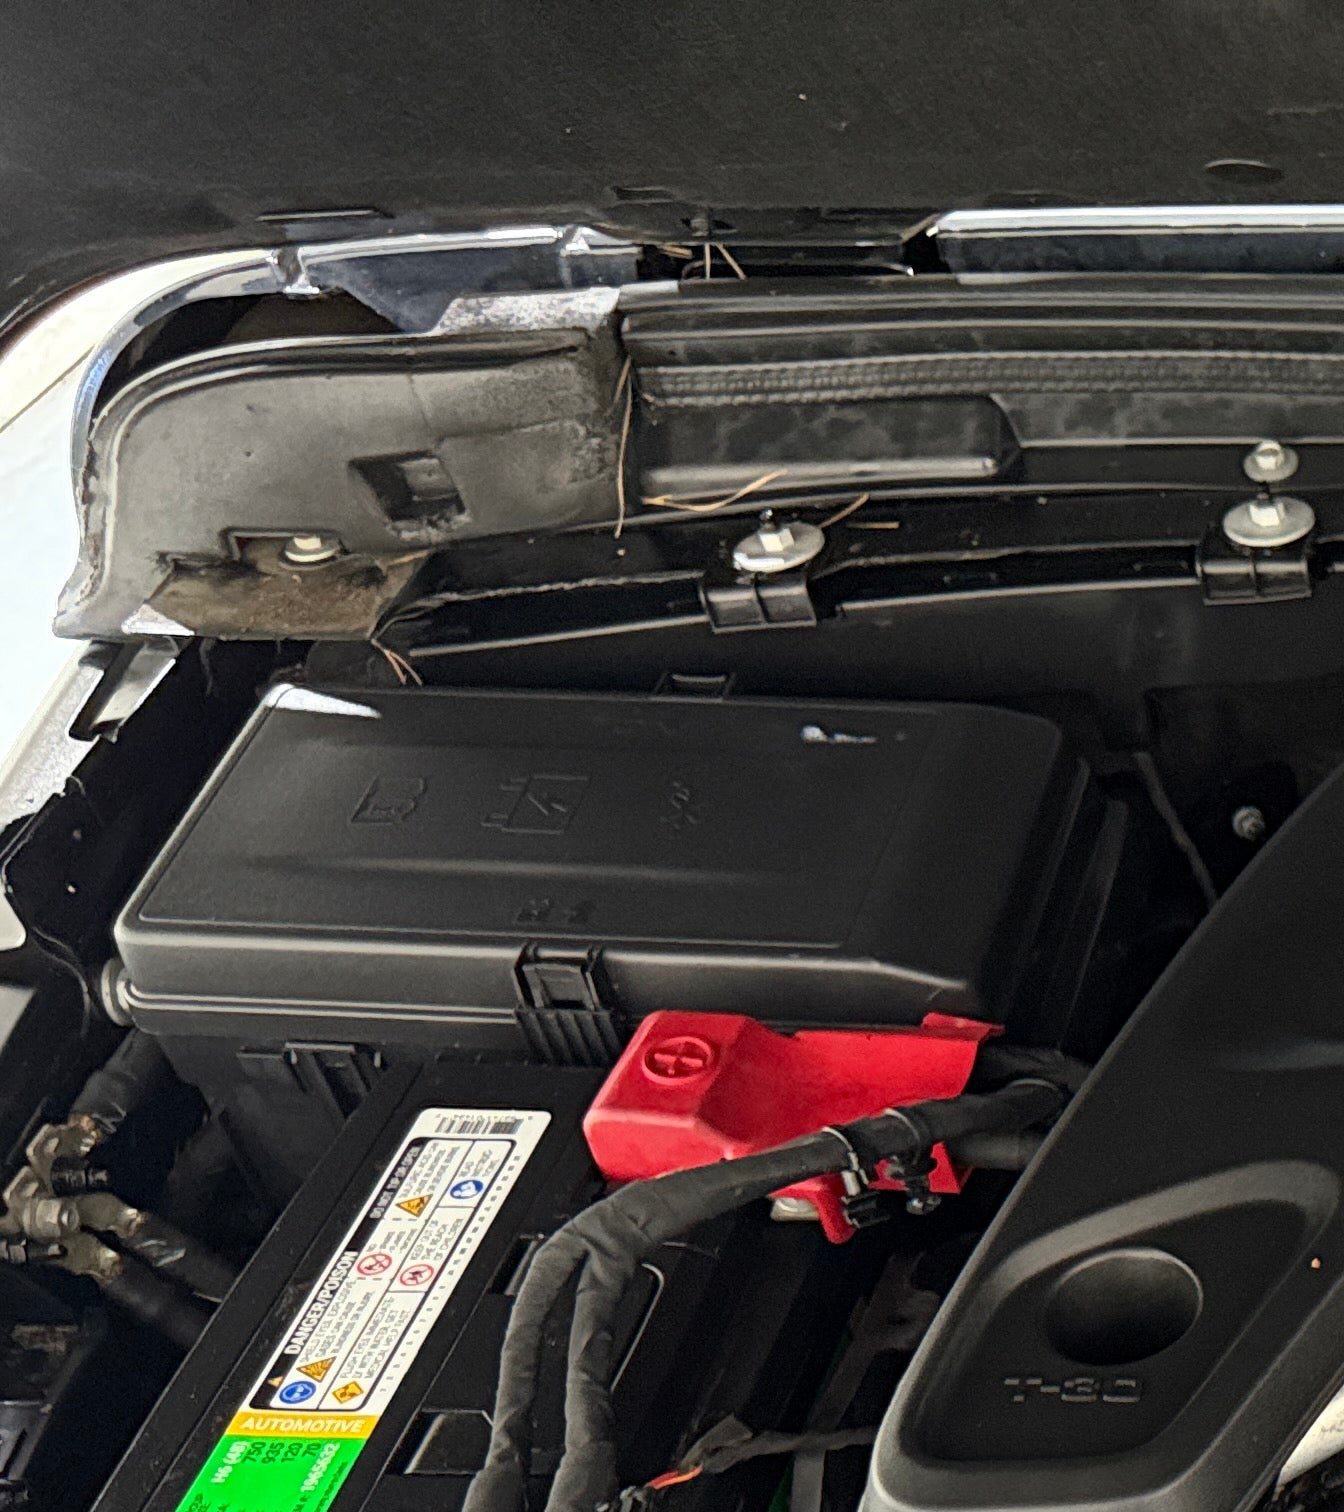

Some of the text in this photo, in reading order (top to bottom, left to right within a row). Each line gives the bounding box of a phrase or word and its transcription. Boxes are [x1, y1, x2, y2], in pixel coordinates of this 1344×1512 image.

[282, 1250, 359, 1354] DANGER/POISON
[240, 1416, 366, 1433] AUTOMOTIVE
[241, 1441, 268, 1462] 750
[297, 1442, 342, 1492] 1965632
